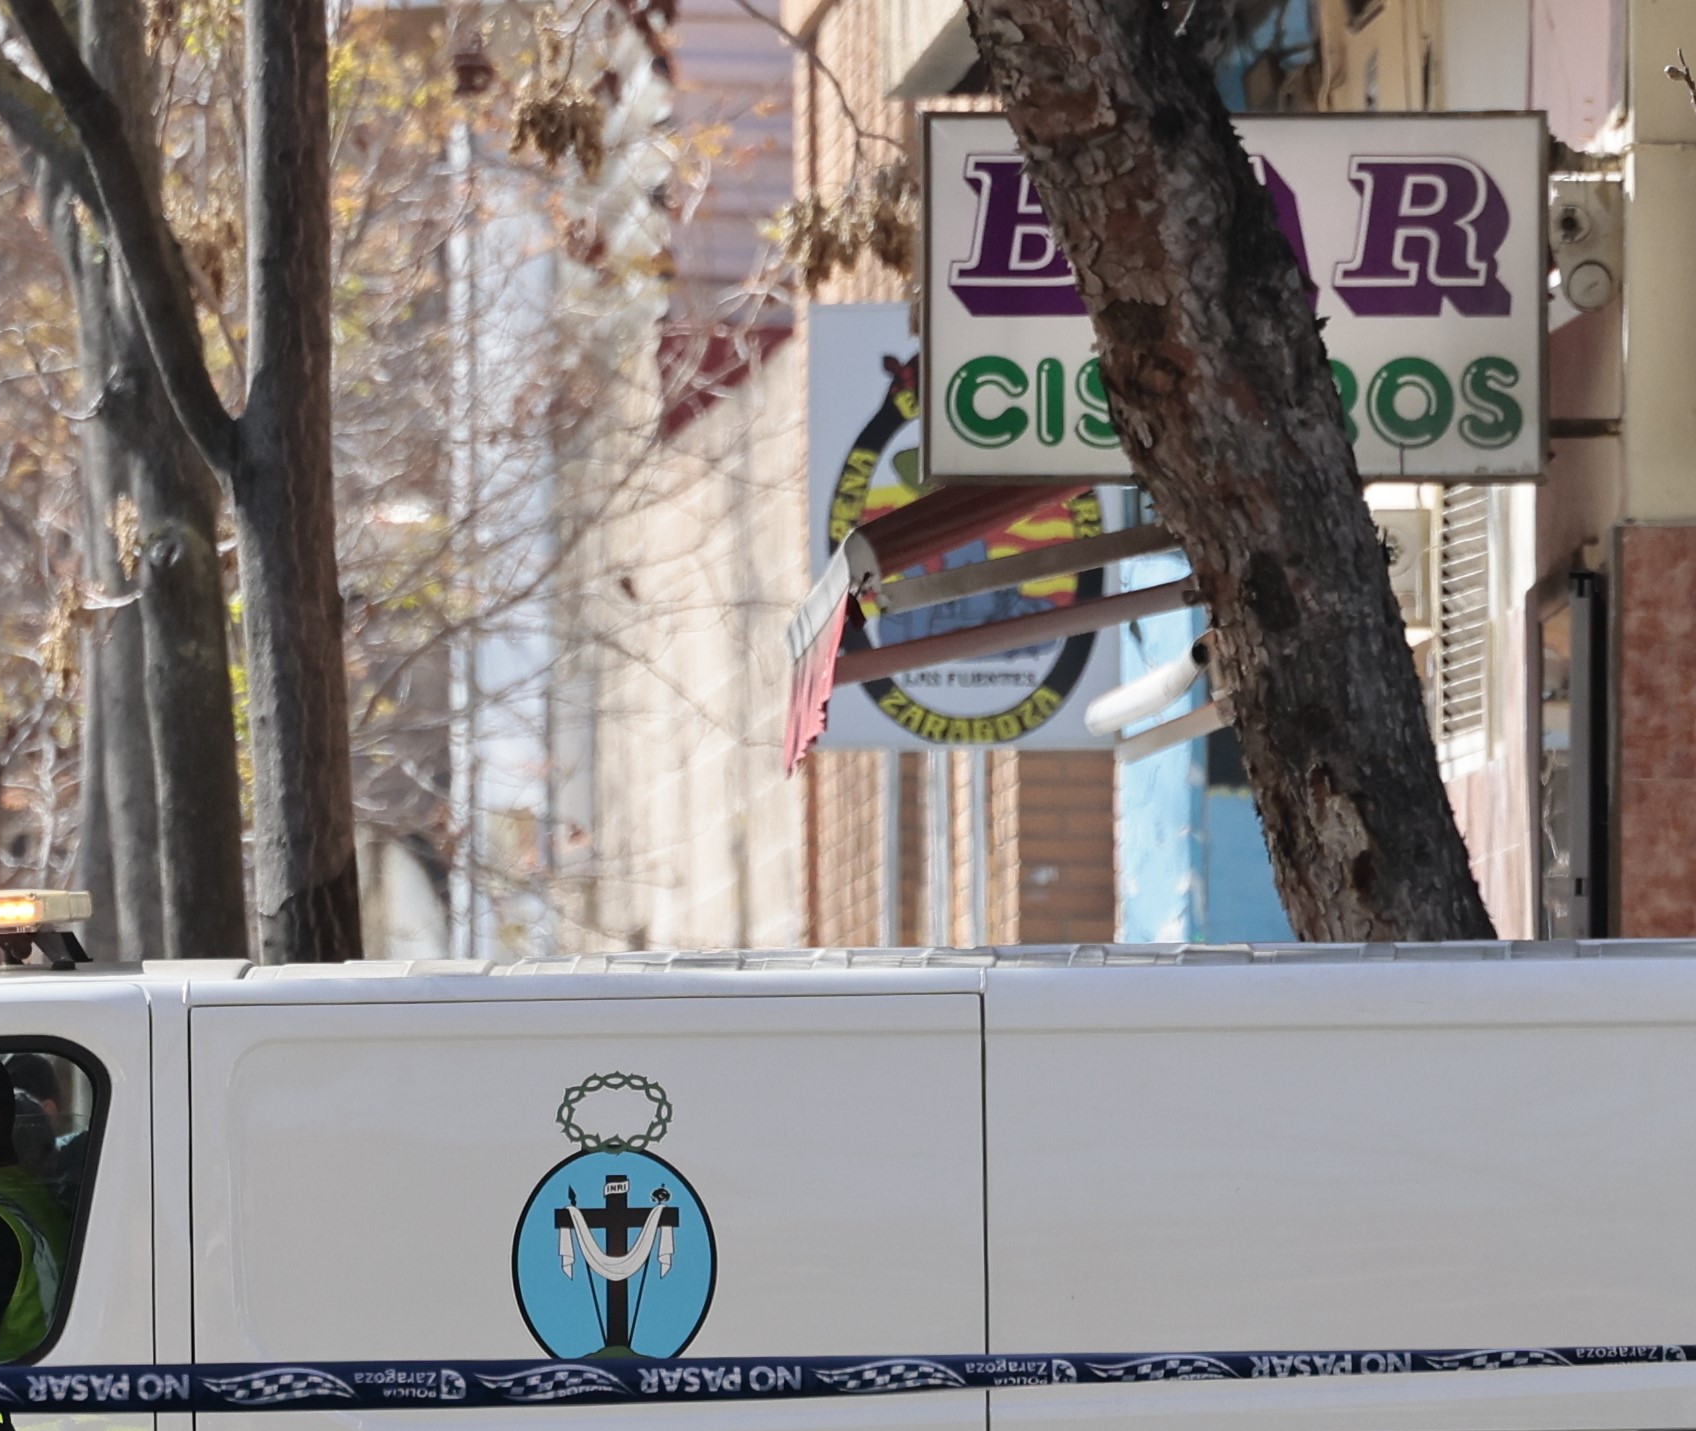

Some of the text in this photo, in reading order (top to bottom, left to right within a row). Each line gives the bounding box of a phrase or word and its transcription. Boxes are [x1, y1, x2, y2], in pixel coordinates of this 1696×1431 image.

[948, 153, 1512, 317] BR
[879, 686, 1063, 744] ZARAGOZA
[606, 1183, 627, 1193] INRI
[965, 1358, 1048, 1374] Zaragoza
[1249, 1352, 1412, 1379] NO PASAR
[1575, 1345, 1659, 1362] Zaragoza
[26, 1374, 191, 1402] NO PASAR
[354, 1369, 438, 1386] Zaragoza
[638, 1366, 742, 1394] PASAR
[749, 1366, 802, 1392] NO
[382, 1386, 437, 1398] POLICIA
